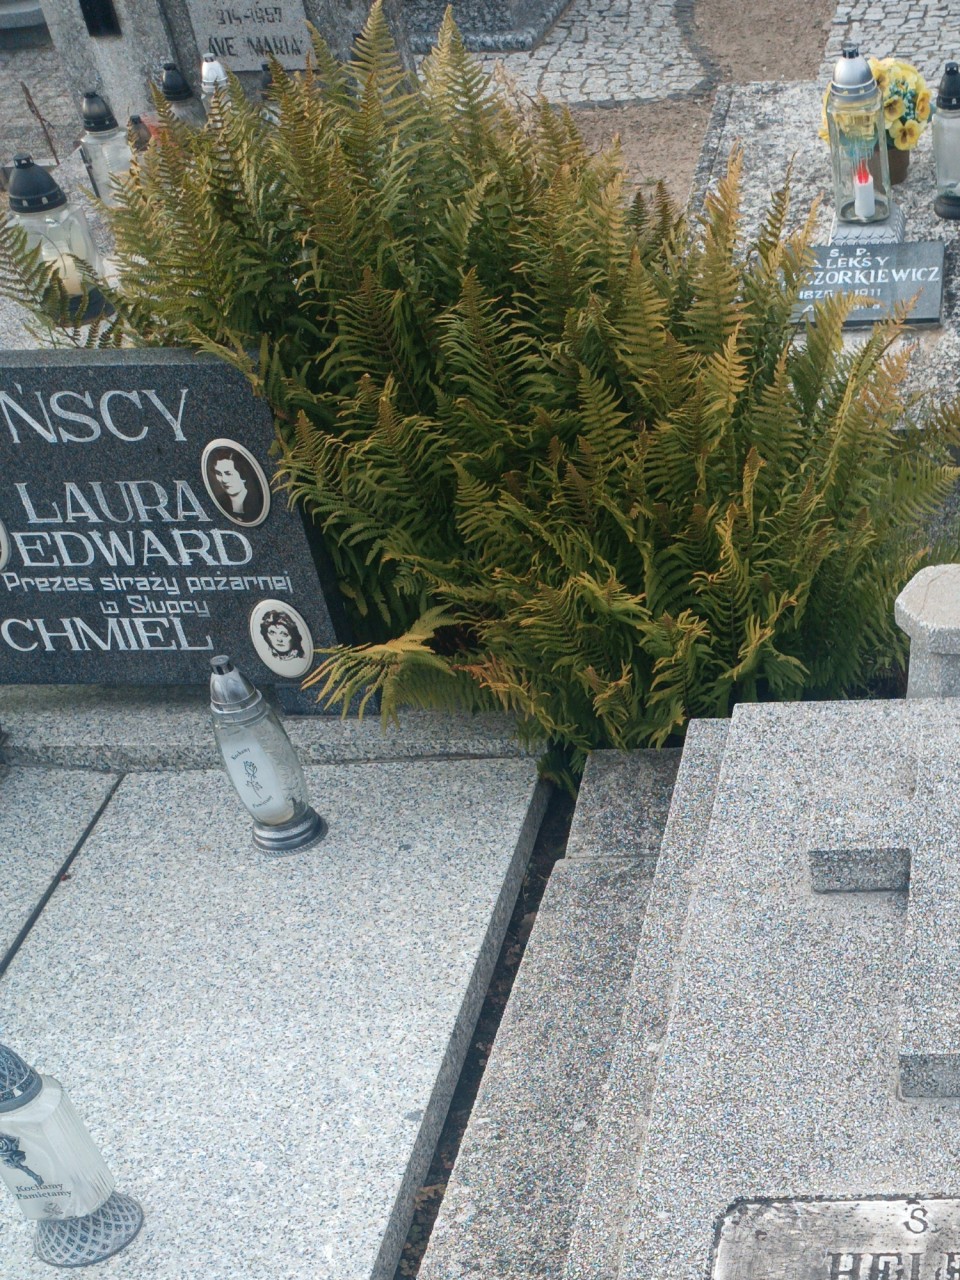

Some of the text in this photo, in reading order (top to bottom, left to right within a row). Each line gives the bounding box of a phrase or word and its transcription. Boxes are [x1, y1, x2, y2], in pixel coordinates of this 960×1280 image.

[14, 480, 213, 524] LAURA
[10, 529, 252, 567] EDWARD
[1, 570, 294, 595] Prezes straży pożarnej
[99, 601, 120, 614] w
[1, 617, 214, 652] CHMIEL
